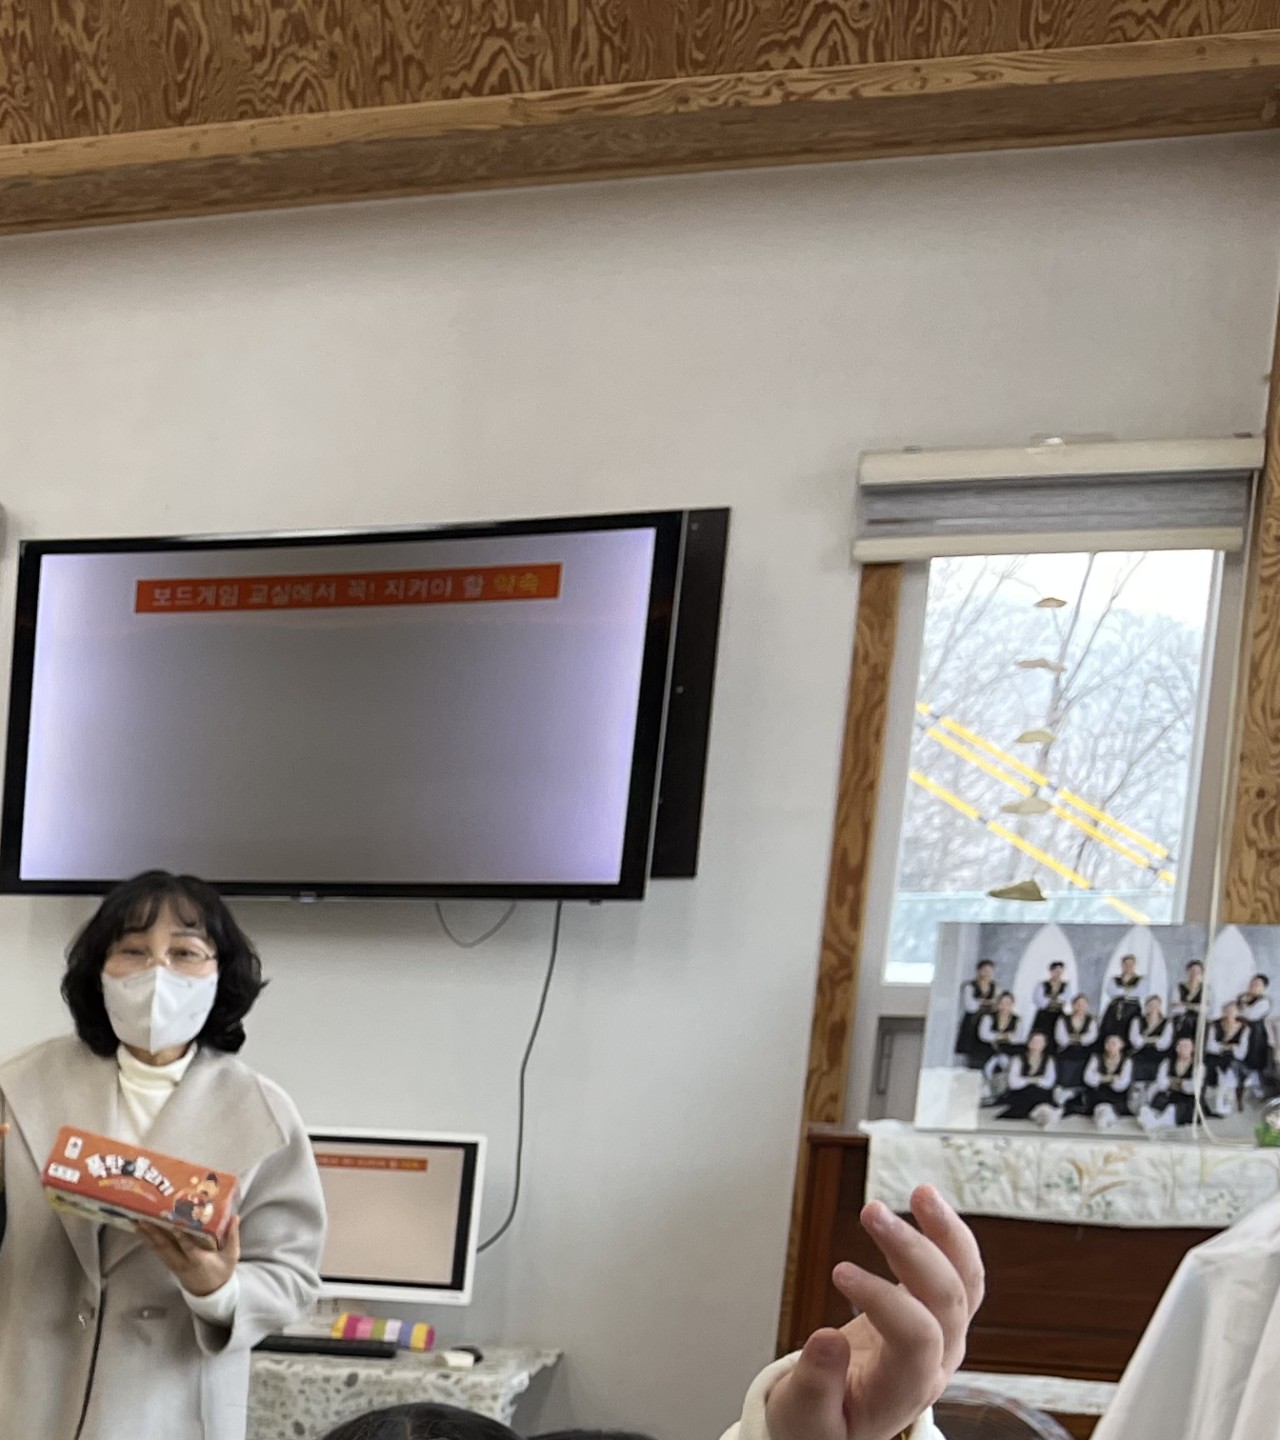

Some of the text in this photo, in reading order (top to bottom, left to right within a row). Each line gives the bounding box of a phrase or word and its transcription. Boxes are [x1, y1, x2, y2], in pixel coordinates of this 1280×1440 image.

[152, 585, 240, 609] 보드게임
[247, 579, 336, 605] 교실에서
[345, 580, 376, 603] 꼭!
[461, 574, 486, 598] 할
[493, 572, 541, 595] 약속
